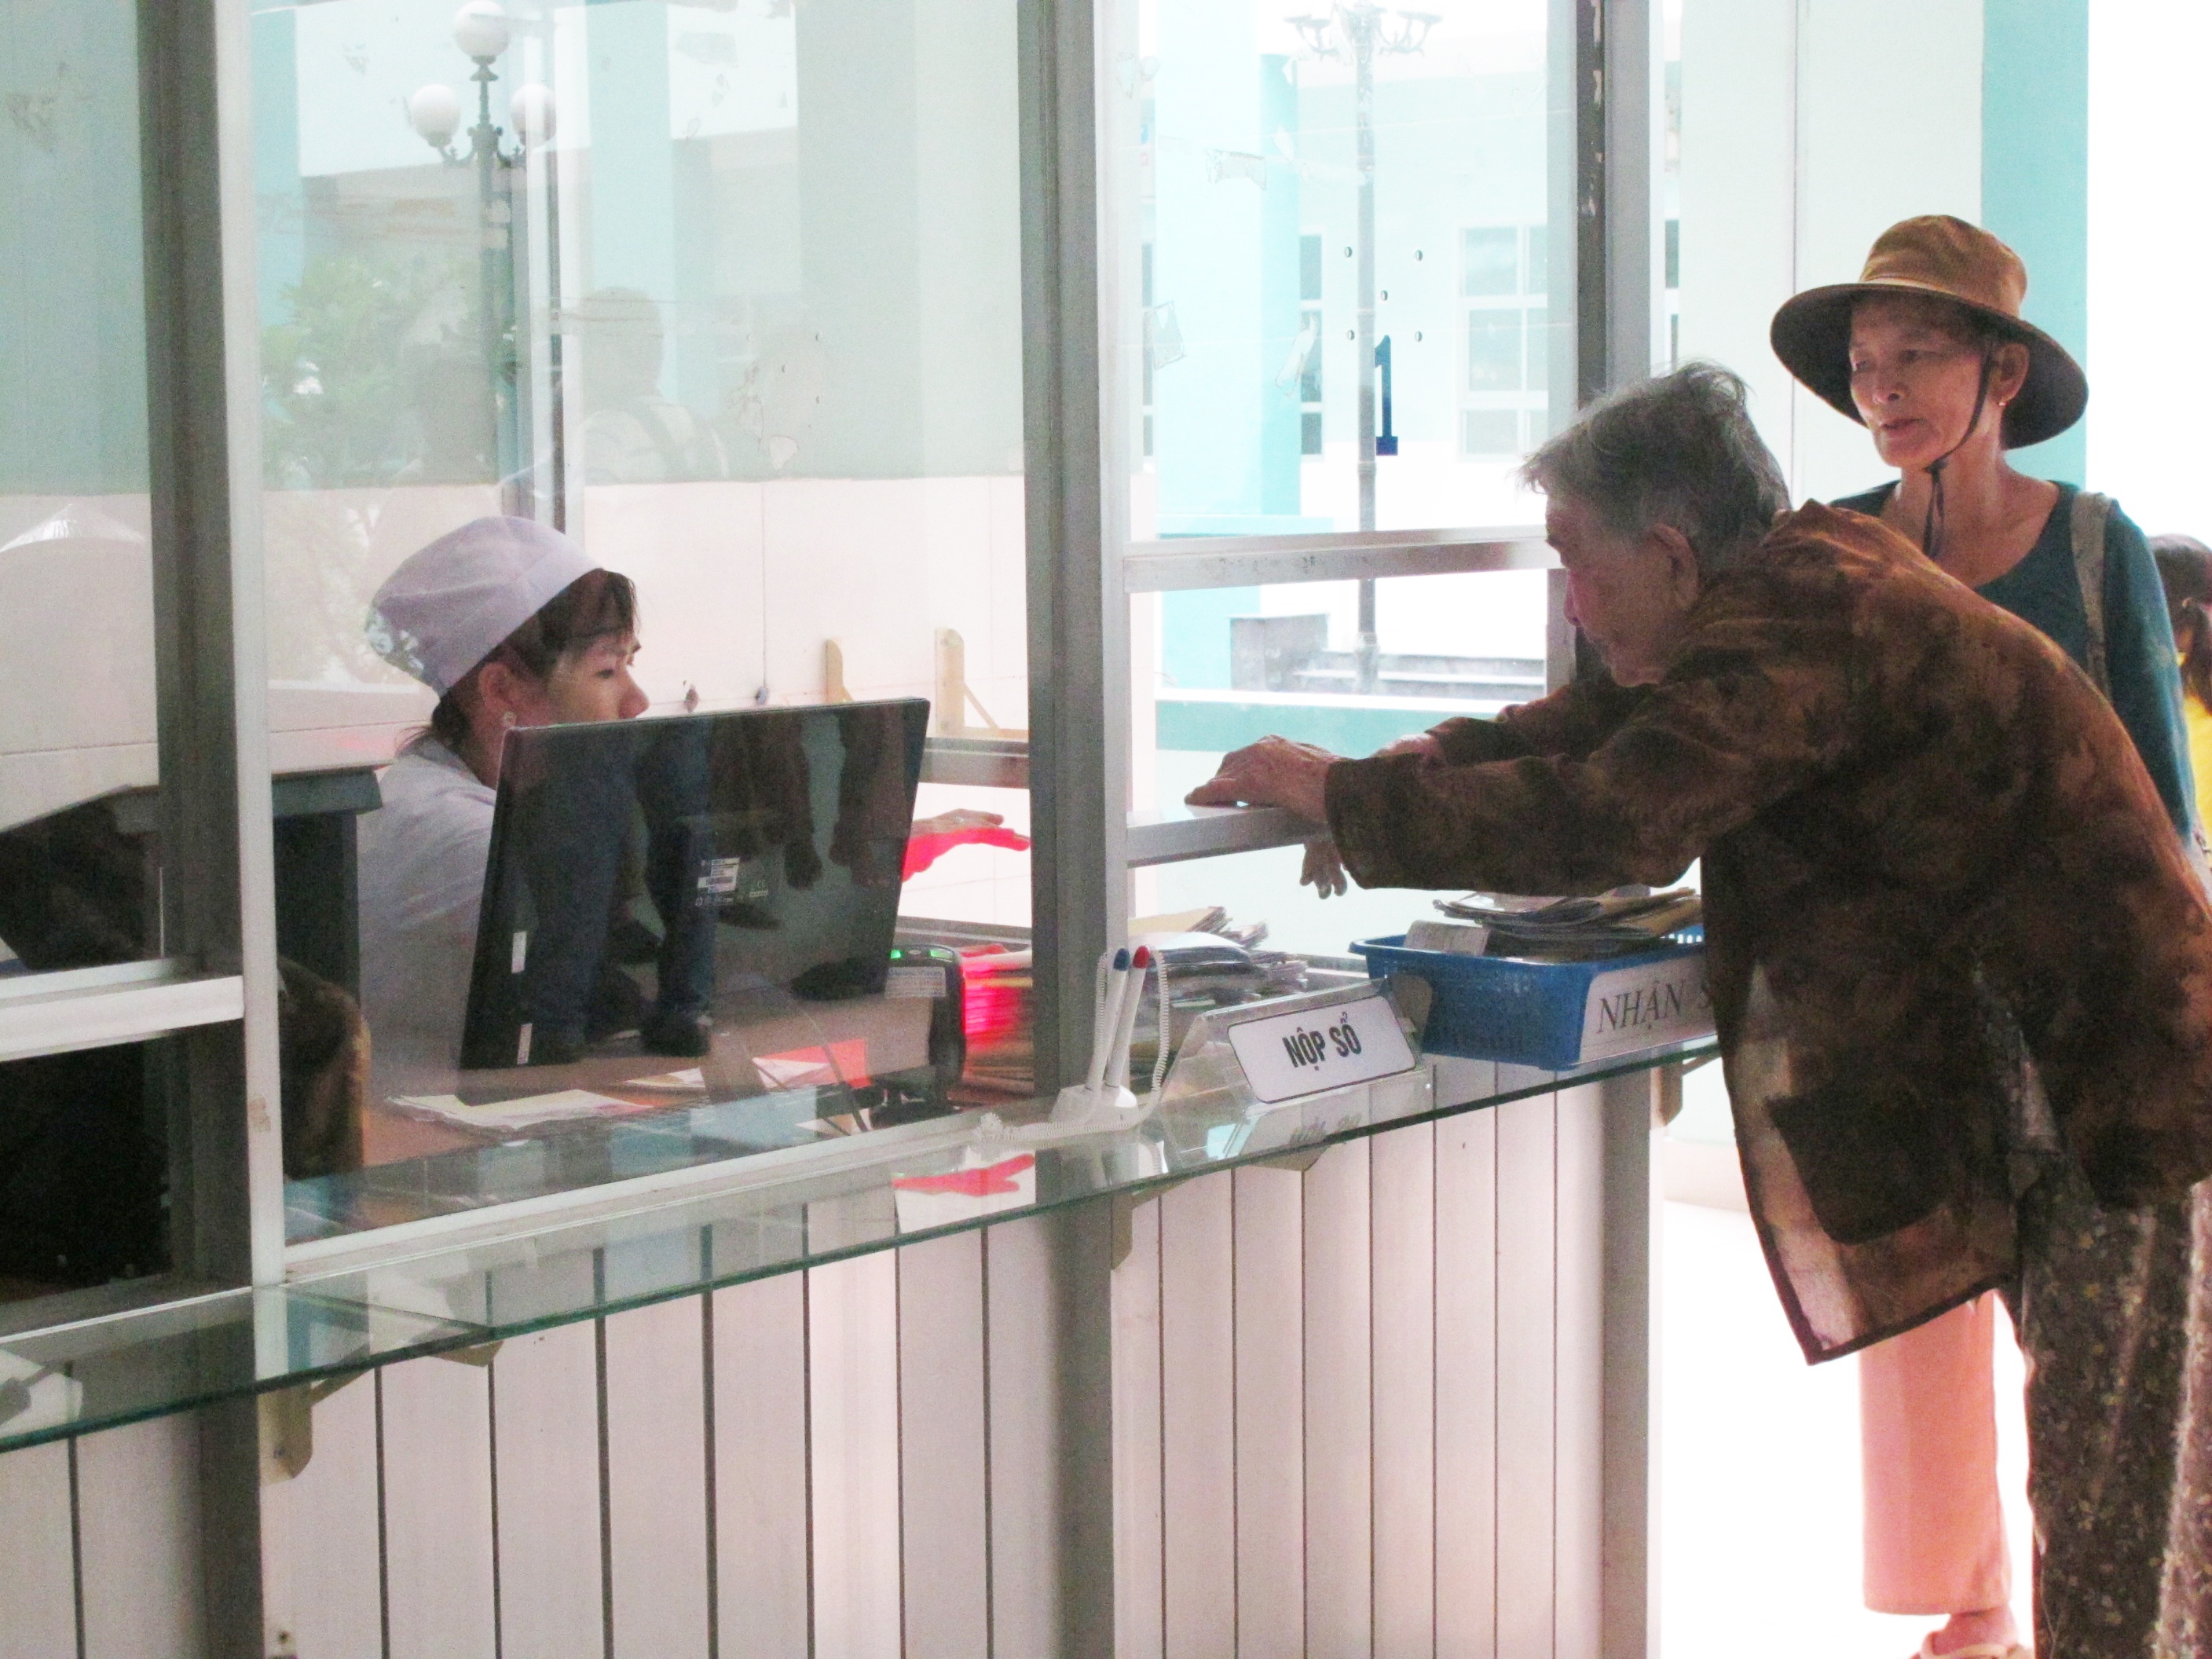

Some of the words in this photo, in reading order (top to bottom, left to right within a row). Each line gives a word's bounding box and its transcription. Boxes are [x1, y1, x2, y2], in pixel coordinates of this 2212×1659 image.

[1375, 335, 1398, 456] 1
[1596, 980, 1685, 1034] NHẬN
[1282, 1026, 1326, 1071] NỘP
[1328, 1011, 1362, 1057] SỔ
